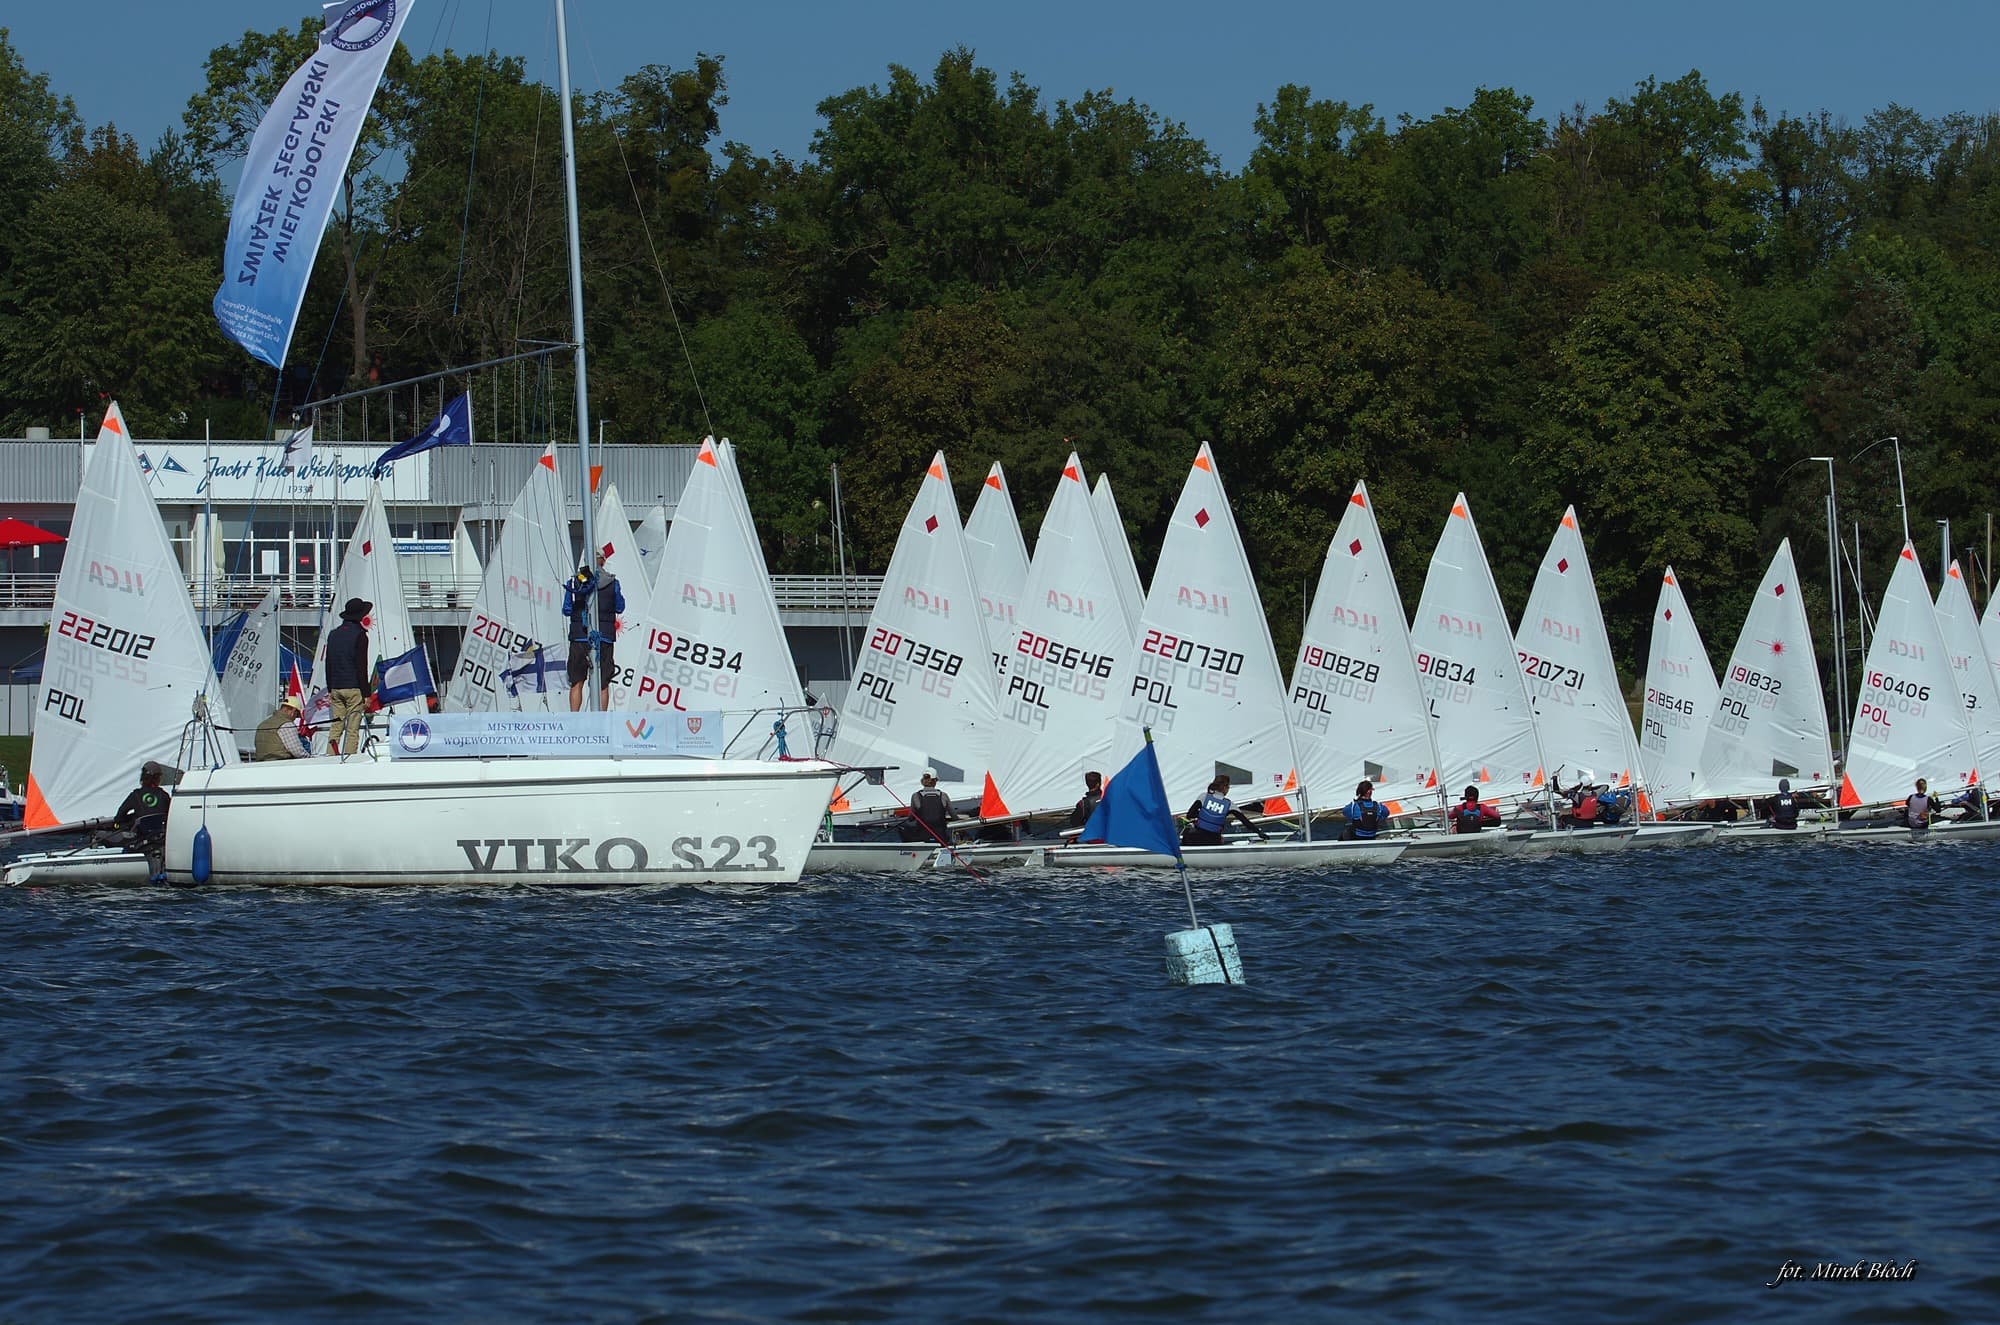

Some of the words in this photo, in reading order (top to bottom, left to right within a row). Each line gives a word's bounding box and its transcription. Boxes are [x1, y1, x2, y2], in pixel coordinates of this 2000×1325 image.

[196, 457, 253, 494] Jacht
[58, 611, 156, 659] 222012
[240, 628, 261, 645] POL
[472, 614, 543, 654] 2009
[231, 650, 262, 672] 29869
[648, 628, 743, 673] 192834
[870, 627, 963, 676] 207358
[1017, 630, 1114, 678] 205646
[1142, 629, 1244, 675] 220730
[1303, 645, 1380, 683] 190828
[459, 658, 496, 693] POL
[1417, 653, 1475, 685] 91834
[1730, 665, 1782, 695] 191832
[638, 676, 686, 711] POL
[857, 672, 896, 704] POL
[1008, 676, 1049, 709] POL
[1131, 675, 1178, 709] POL
[1293, 686, 1332, 714] POL
[1647, 688, 1693, 715] 218546
[1867, 670, 1931, 701] 160406
[44, 688, 86, 724] POL
[1720, 697, 1750, 720] POL
[1860, 703, 1892, 726] POL
[487, 723, 564, 731] MISTRZOSTWA
[528, 735, 609, 745] WIELKOPOLSKI
[1645, 718, 1667, 738] POL
[1206, 800, 1224, 814] HH
[457, 837, 649, 872] VIKO
[671, 835, 785, 872] S23
